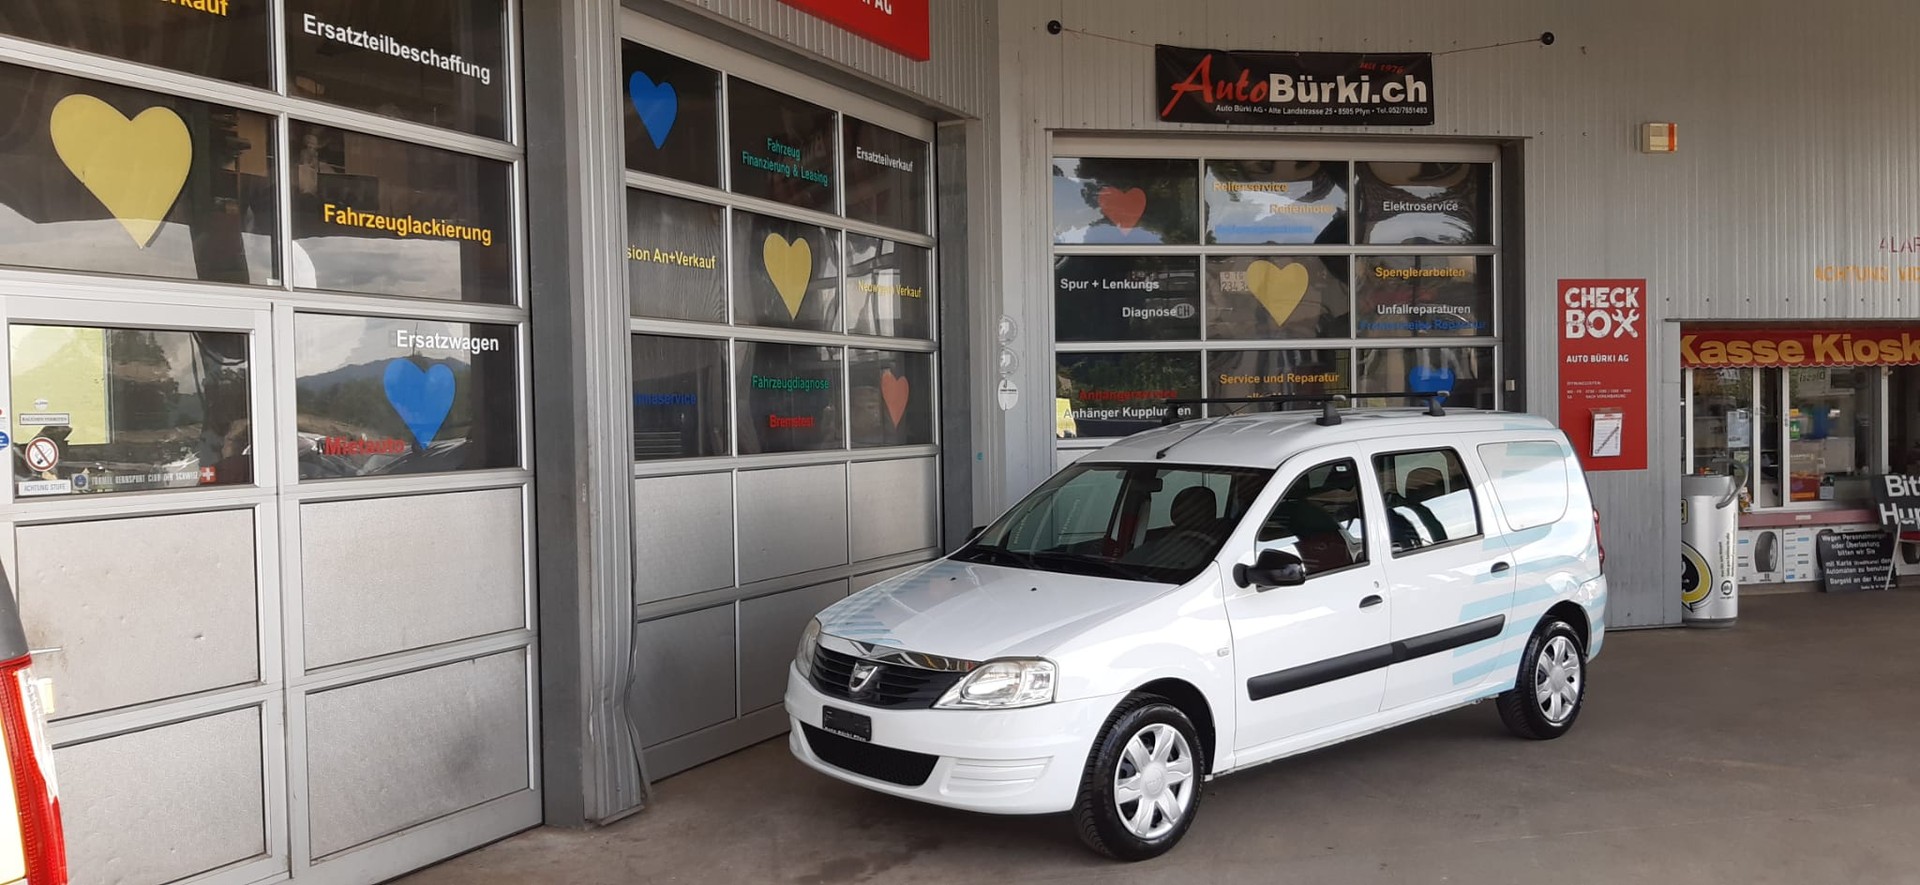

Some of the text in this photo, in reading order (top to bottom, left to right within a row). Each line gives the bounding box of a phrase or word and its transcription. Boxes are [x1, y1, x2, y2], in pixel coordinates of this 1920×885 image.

[303, 13, 491, 85] Ersatzteilbeschaffung
[1215, 105, 1233, 113] Auto
[1268, 106, 1281, 115] Alte
[1282, 106, 1323, 116] Landstrasse
[767, 137, 801, 162] Fahrzeug
[856, 146, 913, 172] Ersatzteilverkauf
[742, 151, 828, 187] Finanzierung & Leasing
[1383, 201, 1458, 211] Elektroservice
[324, 203, 492, 246] Fahrzeuglackierung
[653, 248, 716, 269] An+Verkauf
[1375, 267, 1465, 279] Spenglerarbeiten
[895, 284, 922, 298] Verkauf
[1060, 278, 1160, 292] Spur + Lenkungs
[1565, 287, 1639, 308] CHECK
[1122, 307, 1177, 319] Diagnose
[1377, 304, 1471, 316] Unfallreparaturen
[1566, 309, 1640, 338] BOX
[397, 330, 499, 354] Ersatzwagen
[1681, 334, 1920, 364] Kasse Kiosk
[1567, 355, 1588, 363] AUTO
[1591, 353, 1615, 363] BÜRKI
[752, 375, 829, 392] Fahrzeugdiagnose
[1220, 373, 1339, 385] Service und Reparatur
[1064, 407, 1119, 420] Anhänger
[325, 436, 405, 455] Mietauto
[1884, 474, 1920, 497] Bit
